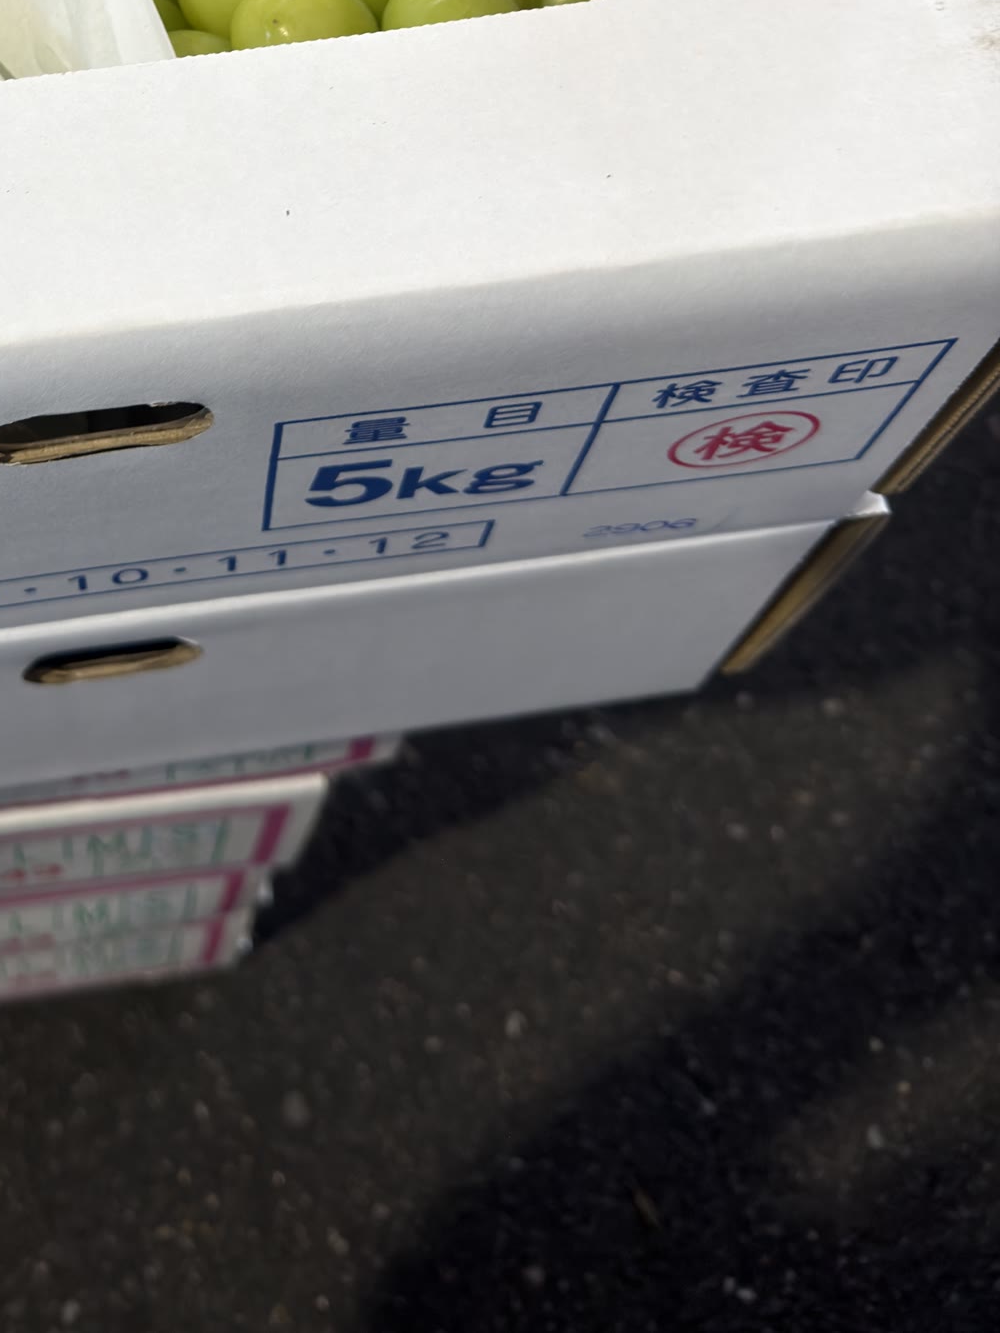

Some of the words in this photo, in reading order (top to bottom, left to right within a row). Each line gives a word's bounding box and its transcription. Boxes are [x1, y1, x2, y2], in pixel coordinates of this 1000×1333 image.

[652, 355, 899, 409] 検査印
[342, 401, 543, 445] 量目
[692, 421, 796, 462] 検
[304, 458, 544, 508] 5kg
